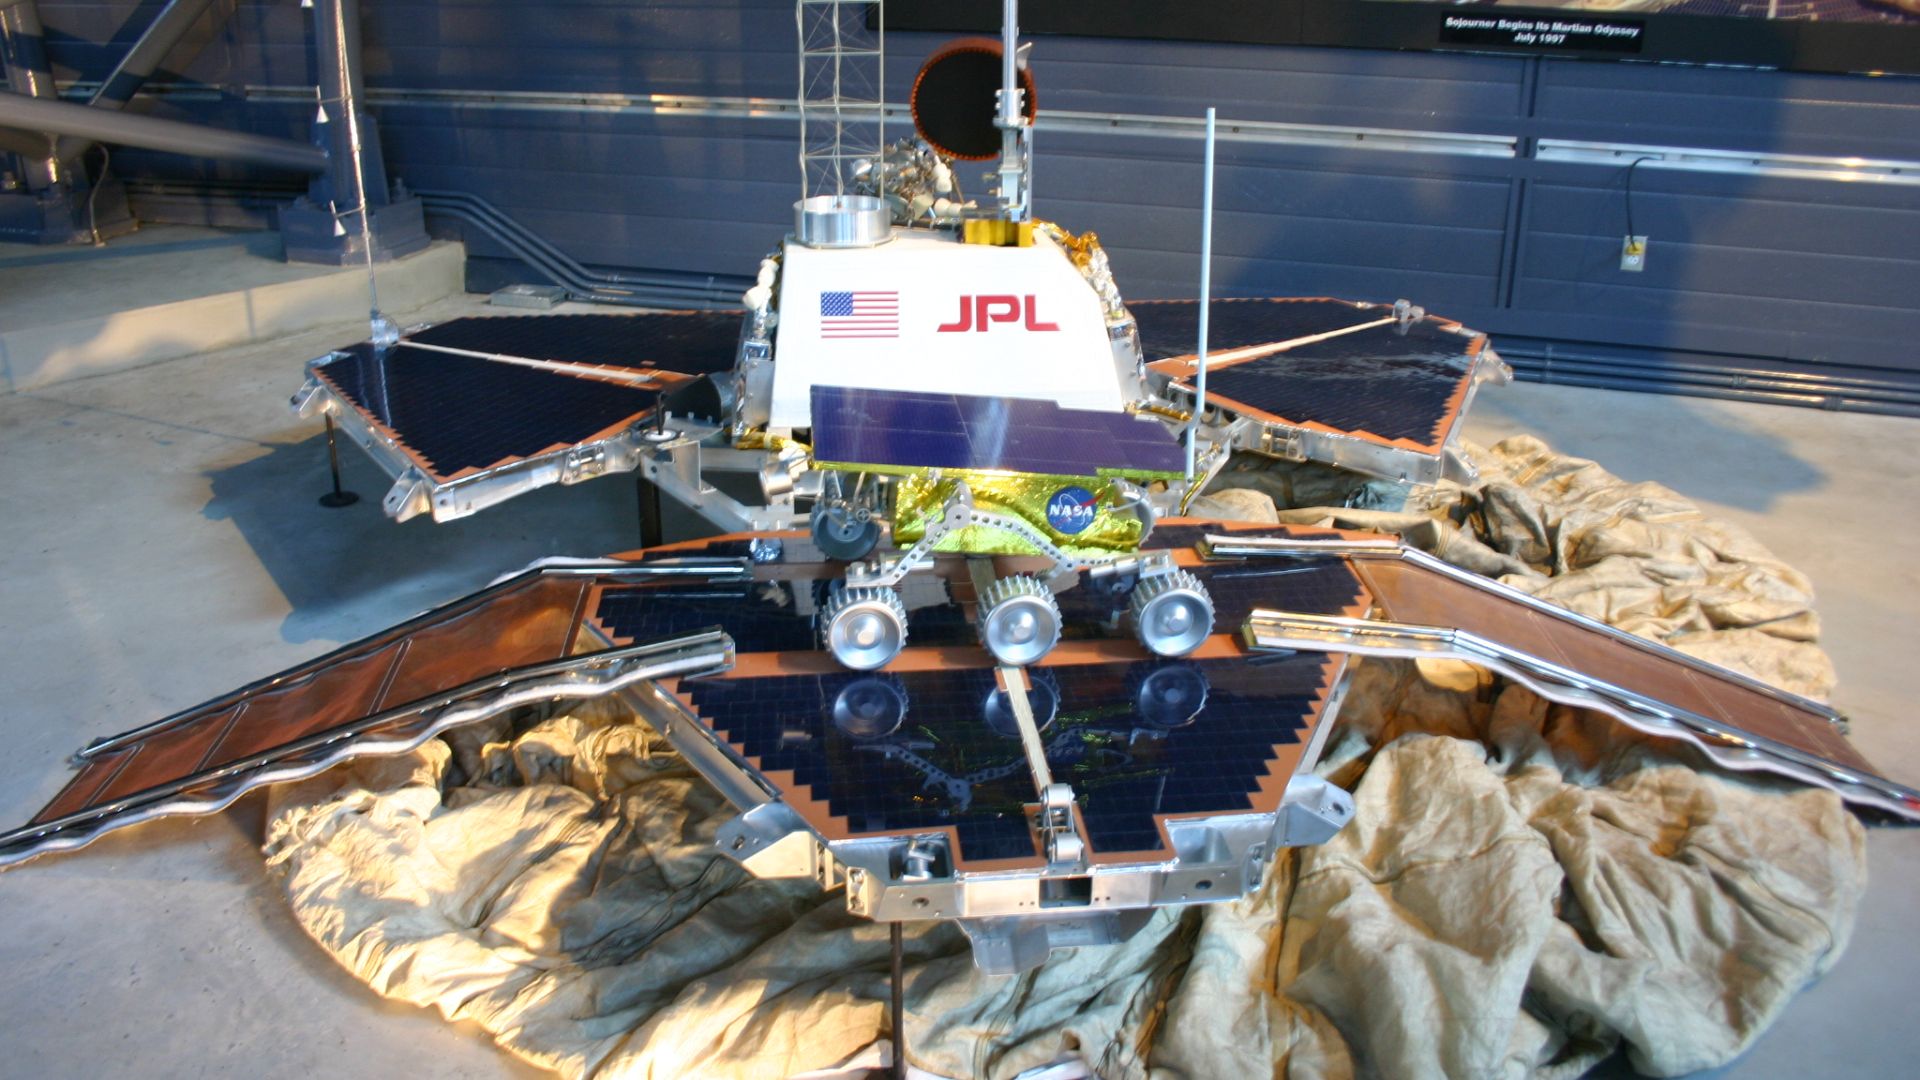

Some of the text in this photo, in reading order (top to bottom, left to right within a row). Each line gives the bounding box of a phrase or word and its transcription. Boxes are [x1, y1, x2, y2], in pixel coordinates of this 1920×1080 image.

[1445, 17, 1640, 38] Sojourner Begins Its Martian Odyssey
[1513, 32, 1566, 44] July 1997
[937, 294, 1062, 332] JPL
[1048, 504, 1094, 517] NASA
